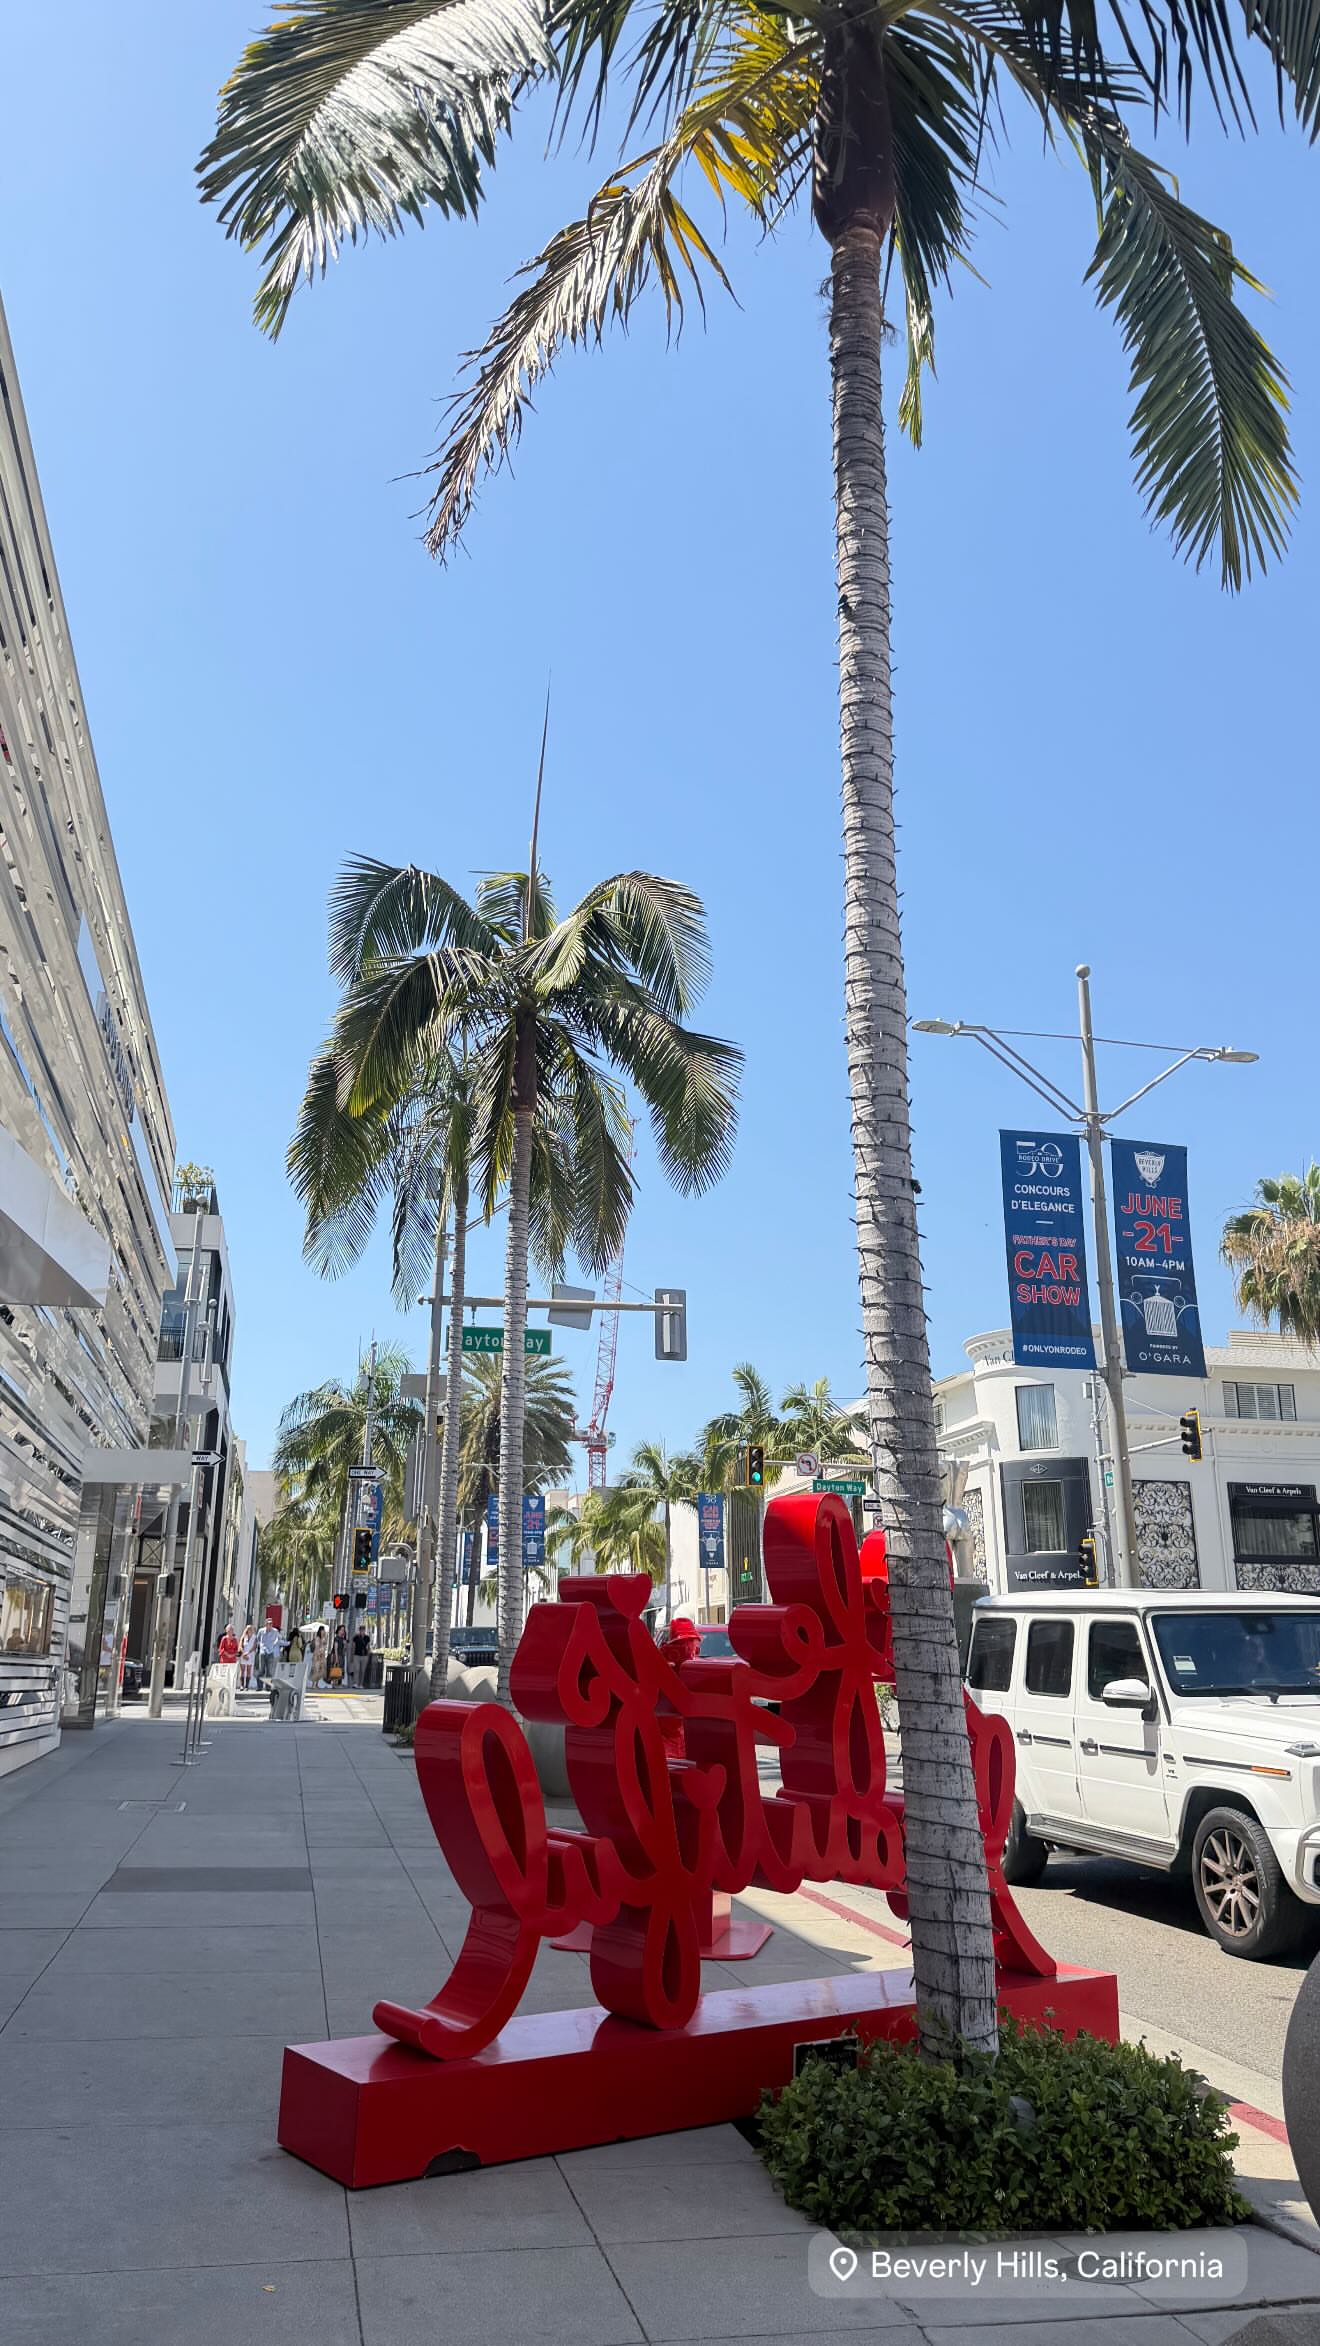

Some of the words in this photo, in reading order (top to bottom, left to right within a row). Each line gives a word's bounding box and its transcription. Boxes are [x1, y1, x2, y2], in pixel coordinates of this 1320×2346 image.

[1014, 1184, 1071, 1197] CONCOURS
[1011, 1200, 1075, 1213] D'ELEGANCE
[1121, 1192, 1183, 1219] JUNE
[1060, 1238, 1077, 1248] DAY
[1014, 1250, 1080, 1281] CAR
[1017, 1283, 1080, 1306] SHOW
[460, 1333, 504, 1350] ayto
[1022, 1344, 1087, 1356] #ONLYONRODEO
[1138, 1351, 1191, 1364] O'GARA
[816, 1483, 845, 1493] Dayton
[847, 1485, 862, 1493] Way
[1245, 1485, 1258, 1494] Van
[1258, 1486, 1276, 1495] Cleef
[1282, 1487, 1302, 1497] Arpels
[1014, 1571, 1028, 1580] Van
[1028, 1570, 1050, 1580] Cleef
[1050, 1572, 1057, 1580] &
